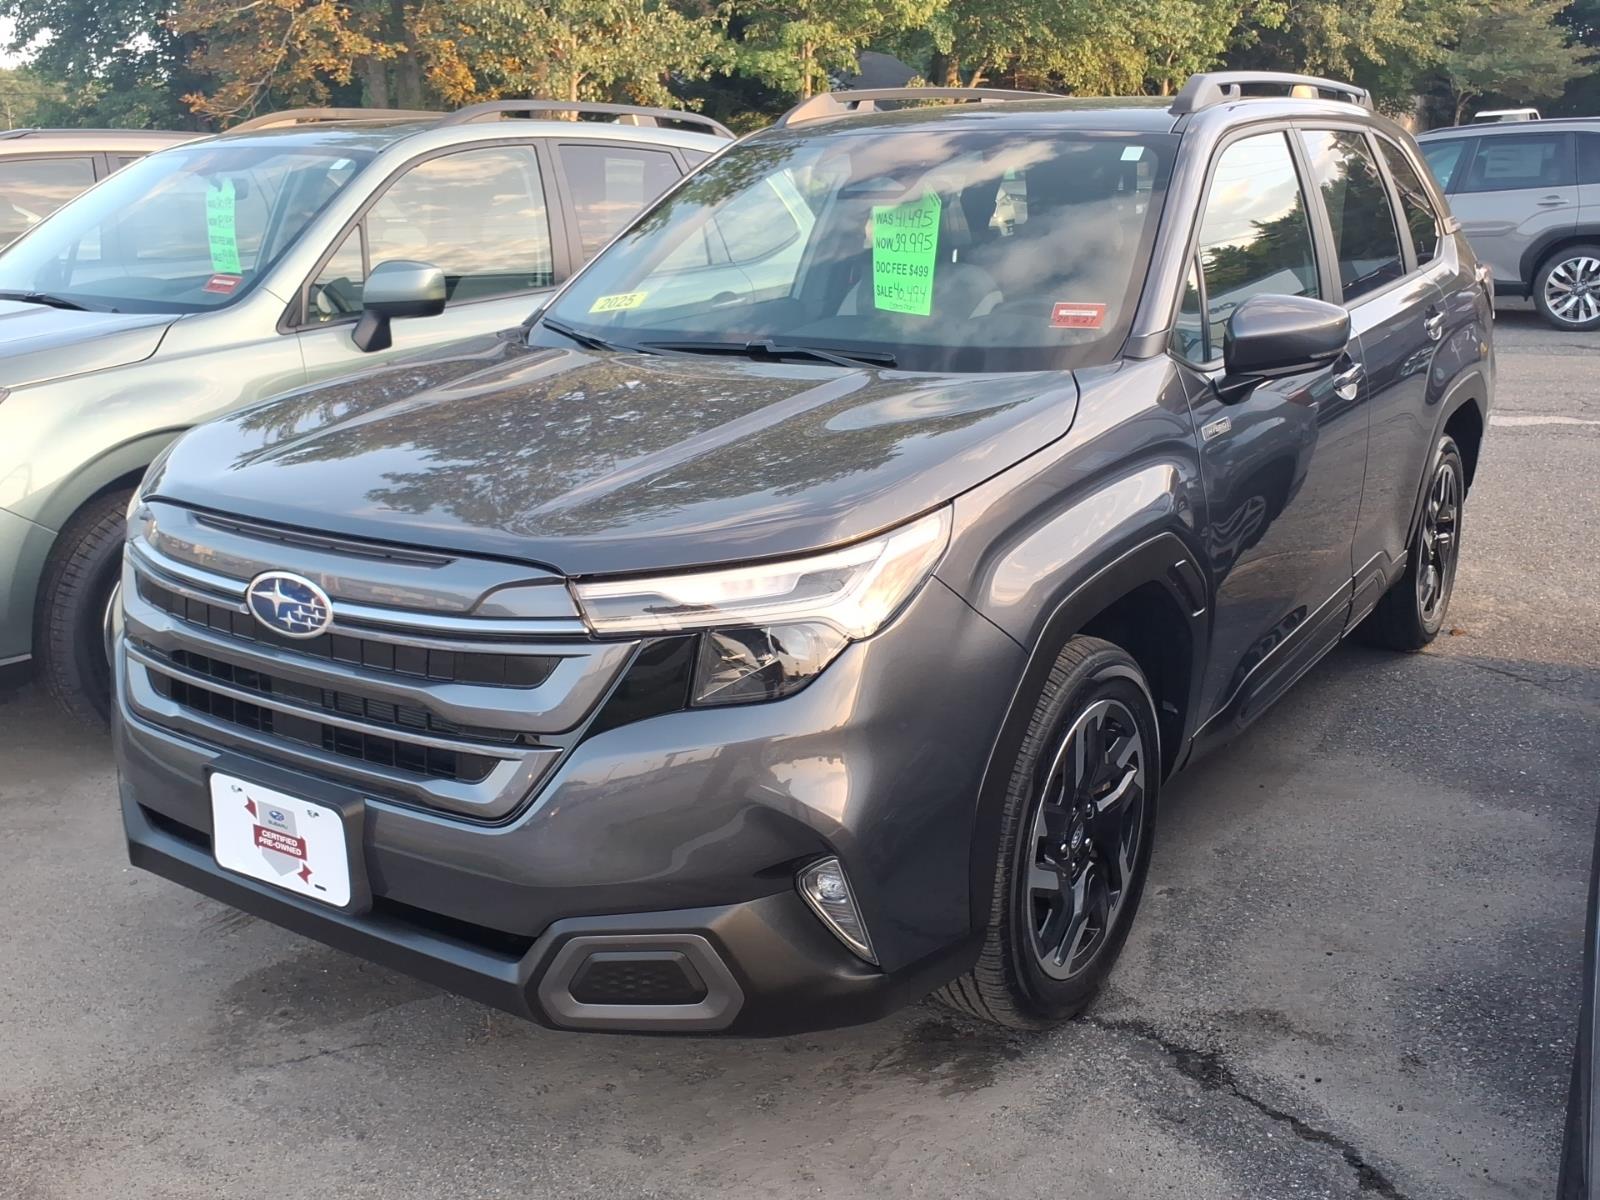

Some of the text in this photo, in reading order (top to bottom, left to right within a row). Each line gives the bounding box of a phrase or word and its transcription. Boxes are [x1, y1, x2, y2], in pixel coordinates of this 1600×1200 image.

[876, 212, 893, 225] WAS
[876, 237, 892, 249] NOW
[876, 261, 929, 278] DOC FEE $499
[876, 284, 893, 297] SALE
[599, 294, 637, 309] 2025
[261, 829, 298, 847] CERTIFIED
[258, 836, 302, 856] PRE-OWNED
